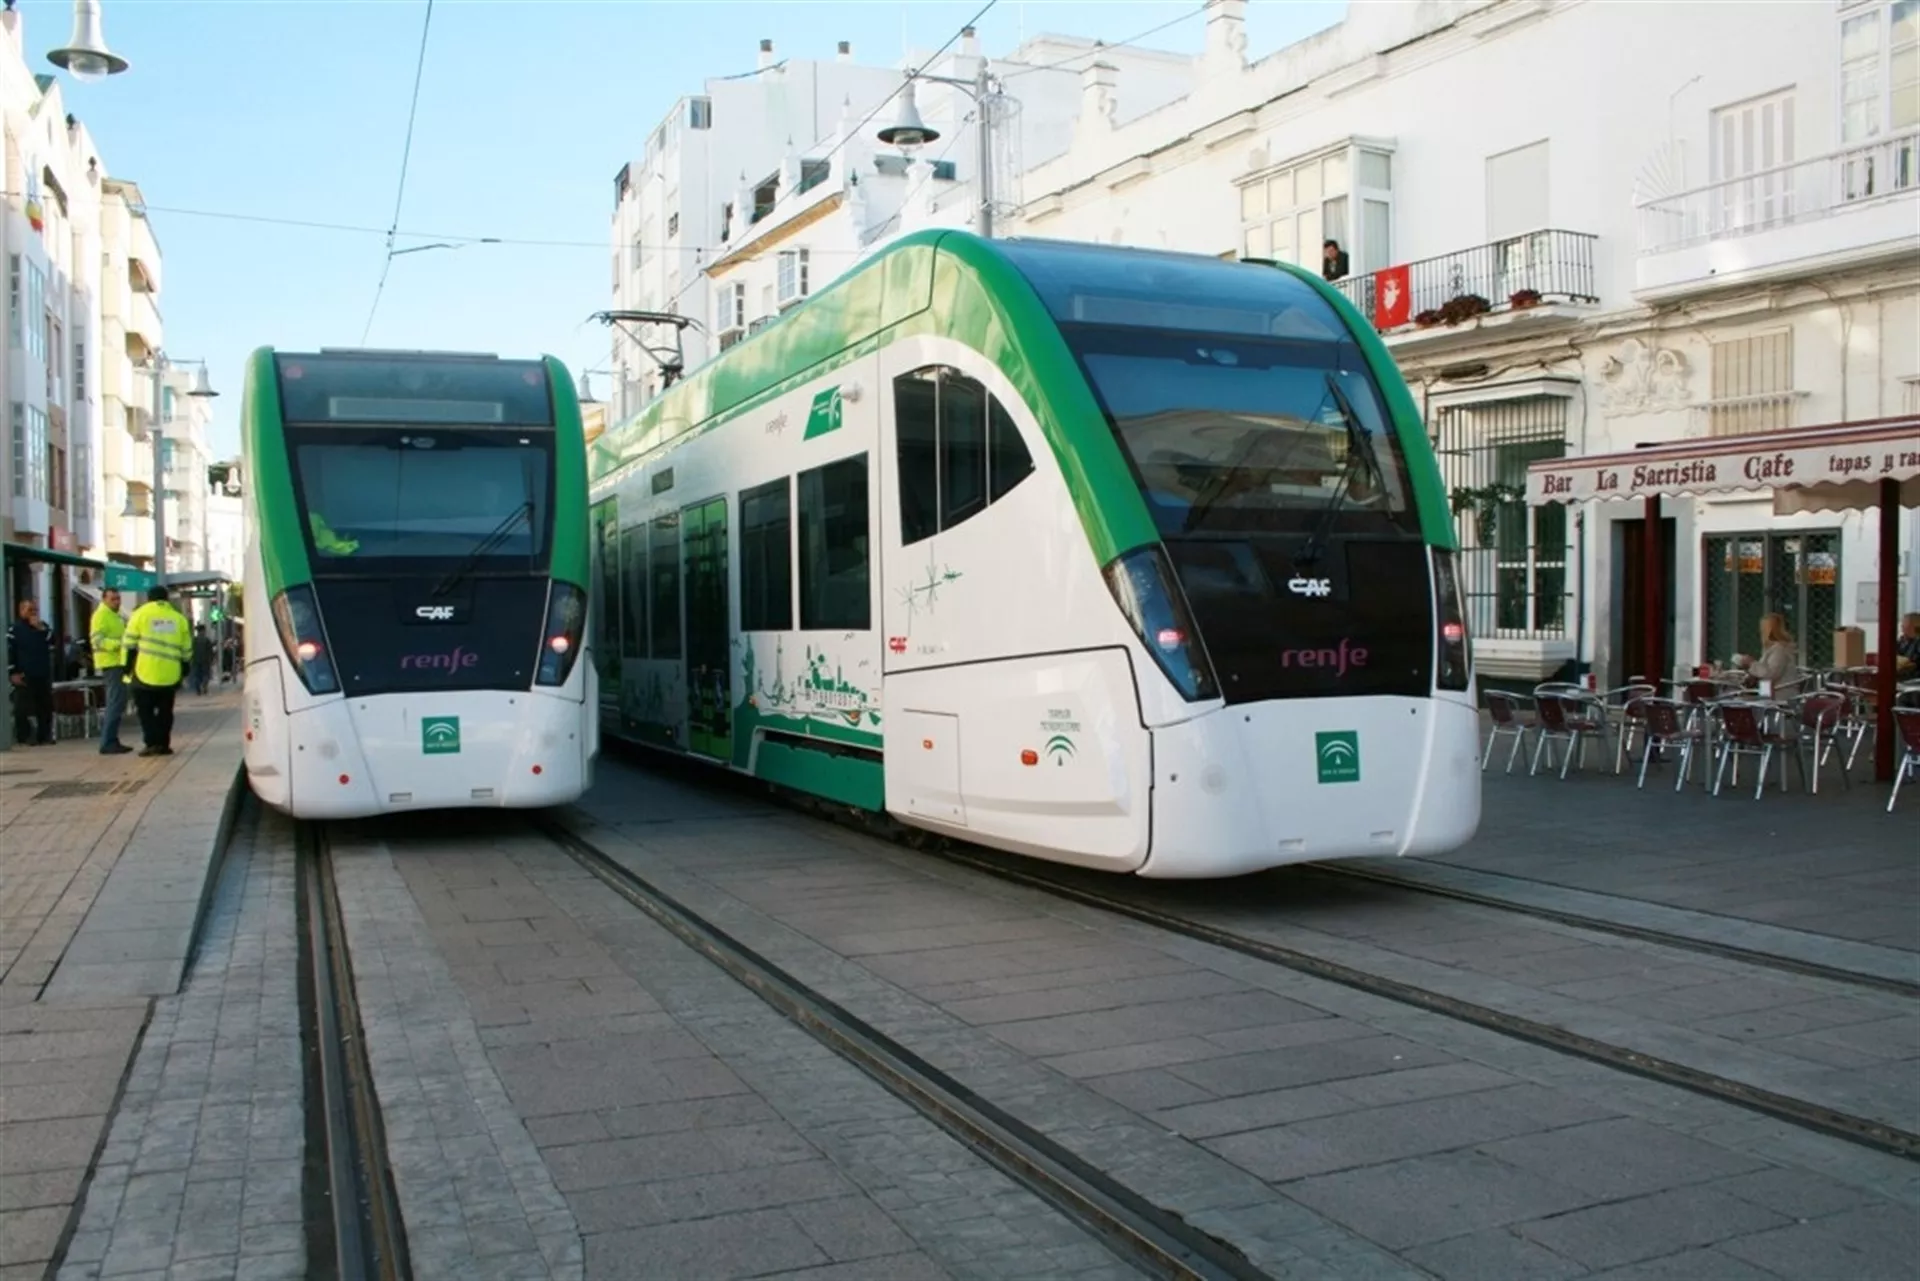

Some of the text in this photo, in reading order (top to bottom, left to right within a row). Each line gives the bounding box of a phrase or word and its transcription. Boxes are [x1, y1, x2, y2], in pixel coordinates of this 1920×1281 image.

[1542, 474, 1573, 494] Bar
[1594, 470, 1618, 491] La
[1630, 460, 1717, 491] Sacristia
[1743, 453, 1794, 482] Cafe
[1829, 455, 1872, 475] tapas
[1880, 454, 1894, 473] y
[1288, 577, 1331, 597] CAF
[416, 605, 454, 620] CAF
[401, 646, 478, 675] renfe
[1281, 637, 1368, 677] renfe
